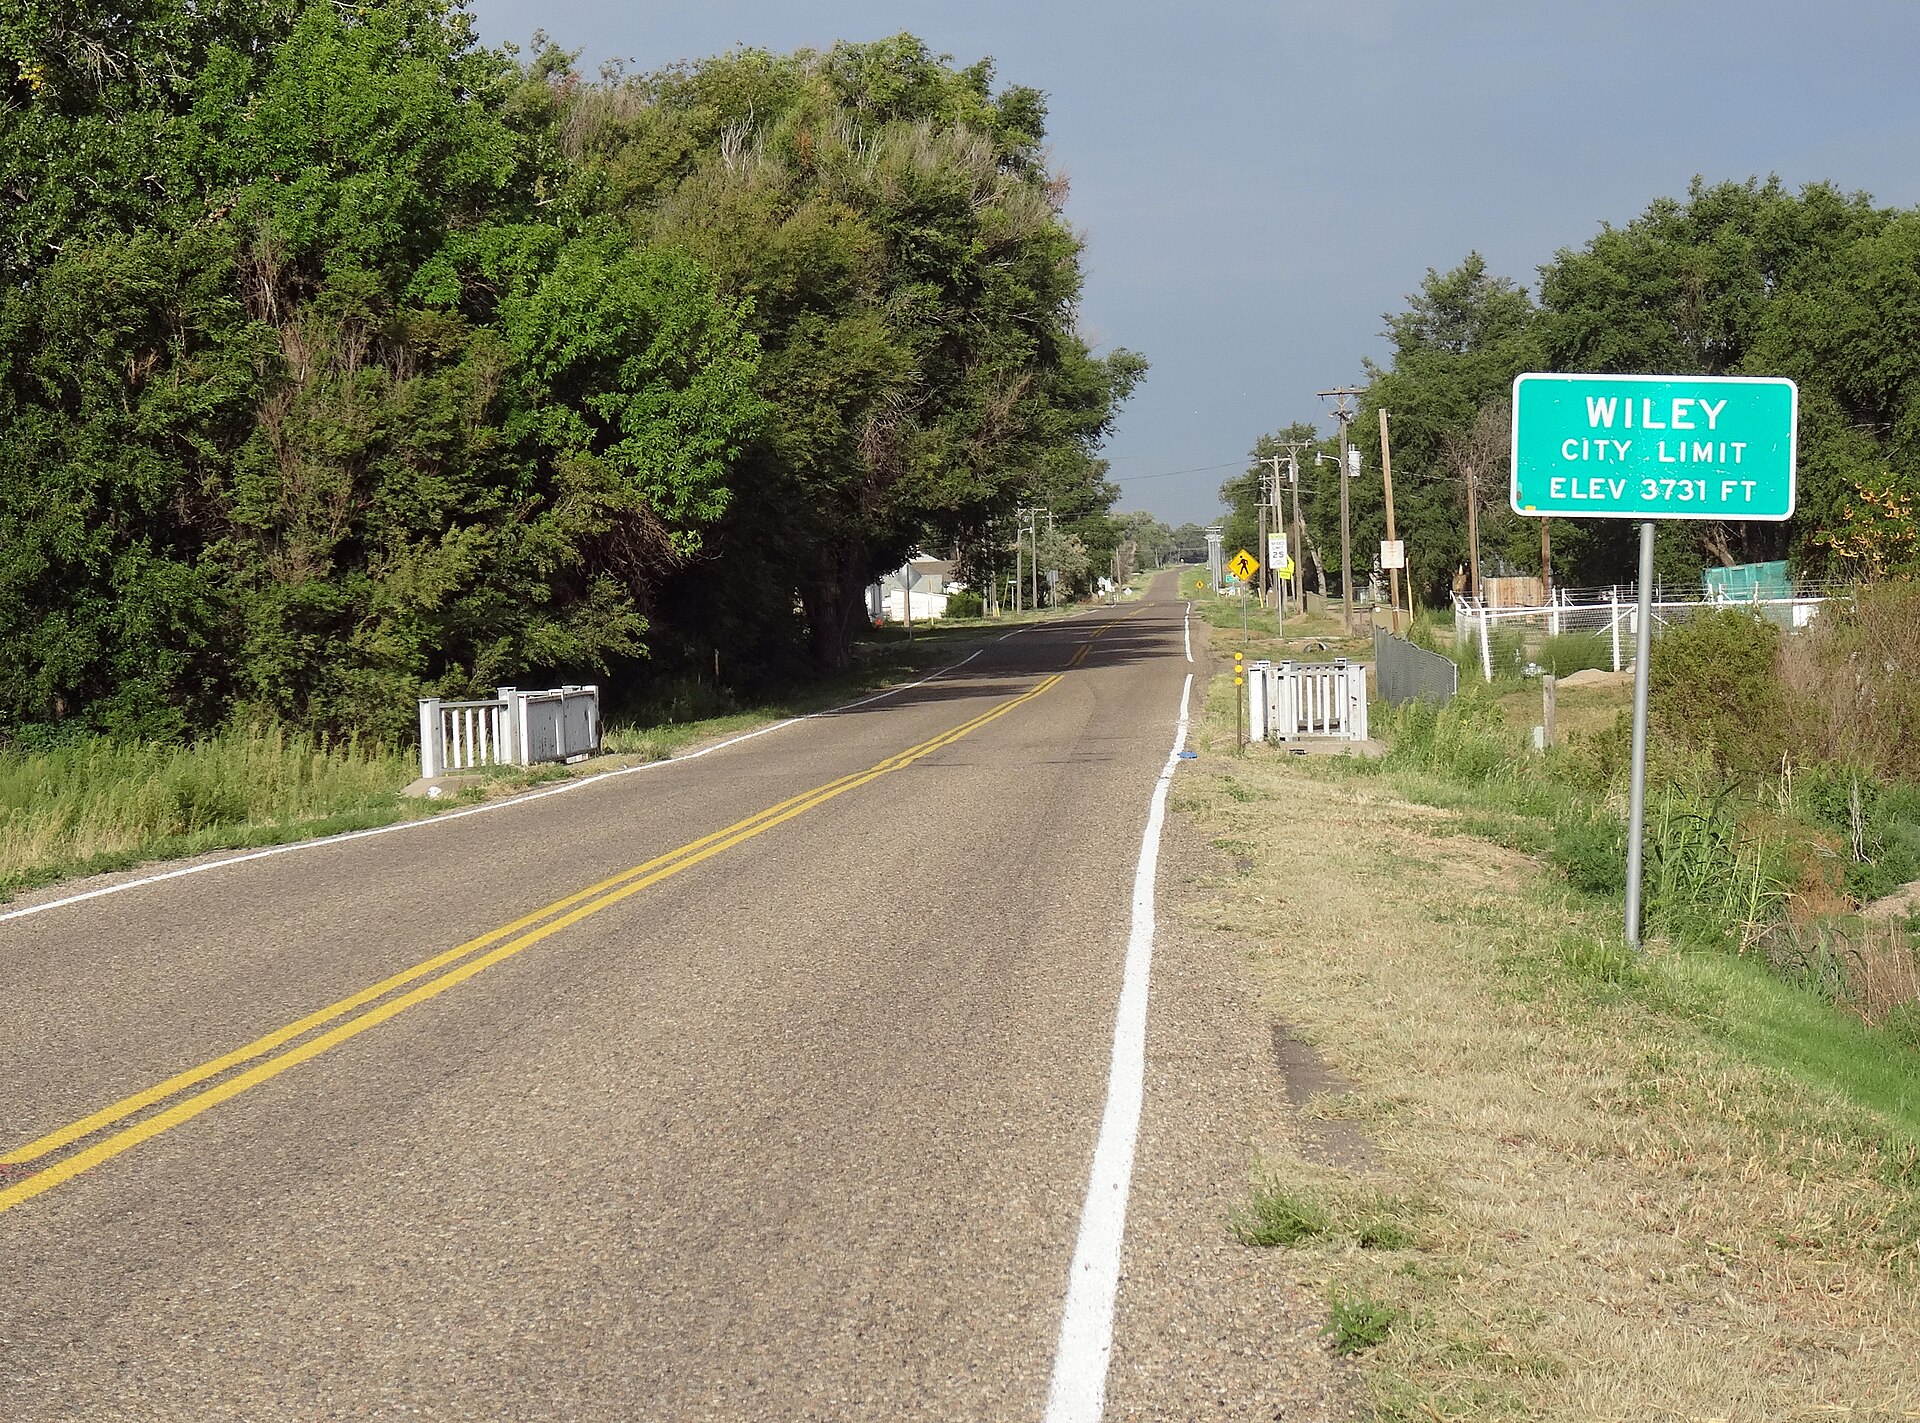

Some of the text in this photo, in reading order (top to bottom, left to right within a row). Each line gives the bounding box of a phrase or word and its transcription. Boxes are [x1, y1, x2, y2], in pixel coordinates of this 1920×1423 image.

[1586, 396, 1727, 430] WILEY
[1561, 439, 1747, 463] CITY LIMIT
[1550, 477, 1757, 502] ELEV 3731 FT
[1272, 551, 1284, 559] 25
